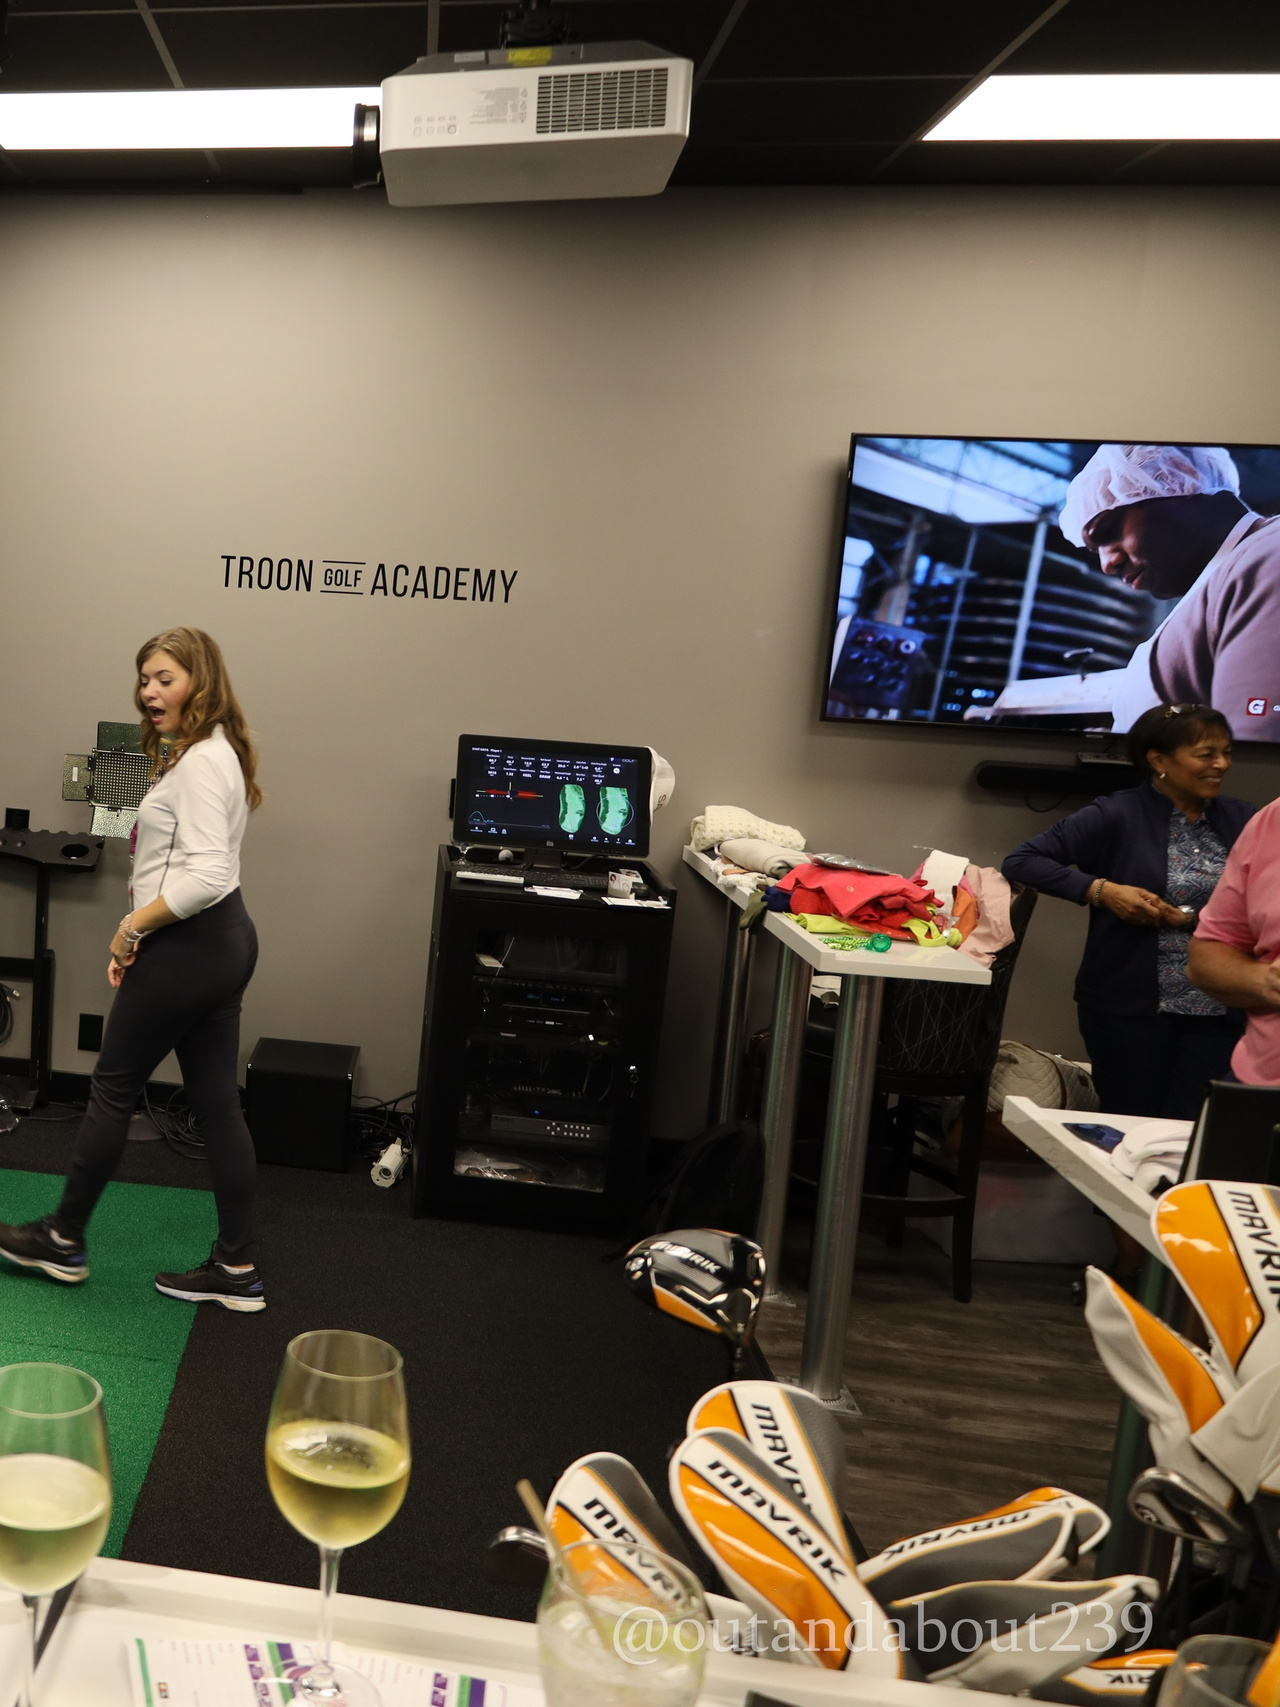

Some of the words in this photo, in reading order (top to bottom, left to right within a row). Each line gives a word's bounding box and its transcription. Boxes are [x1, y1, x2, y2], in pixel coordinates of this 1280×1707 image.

[220, 555, 314, 593] TROON
[323, 568, 363, 588] GOLF
[369, 563, 519, 603] ACADEMY
[1248, 699, 1266, 715] G
[751, 1402, 812, 1512] MAVR
[707, 1458, 848, 1586] MAVRIK
[882, 1511, 1031, 1561] MAVRIK
